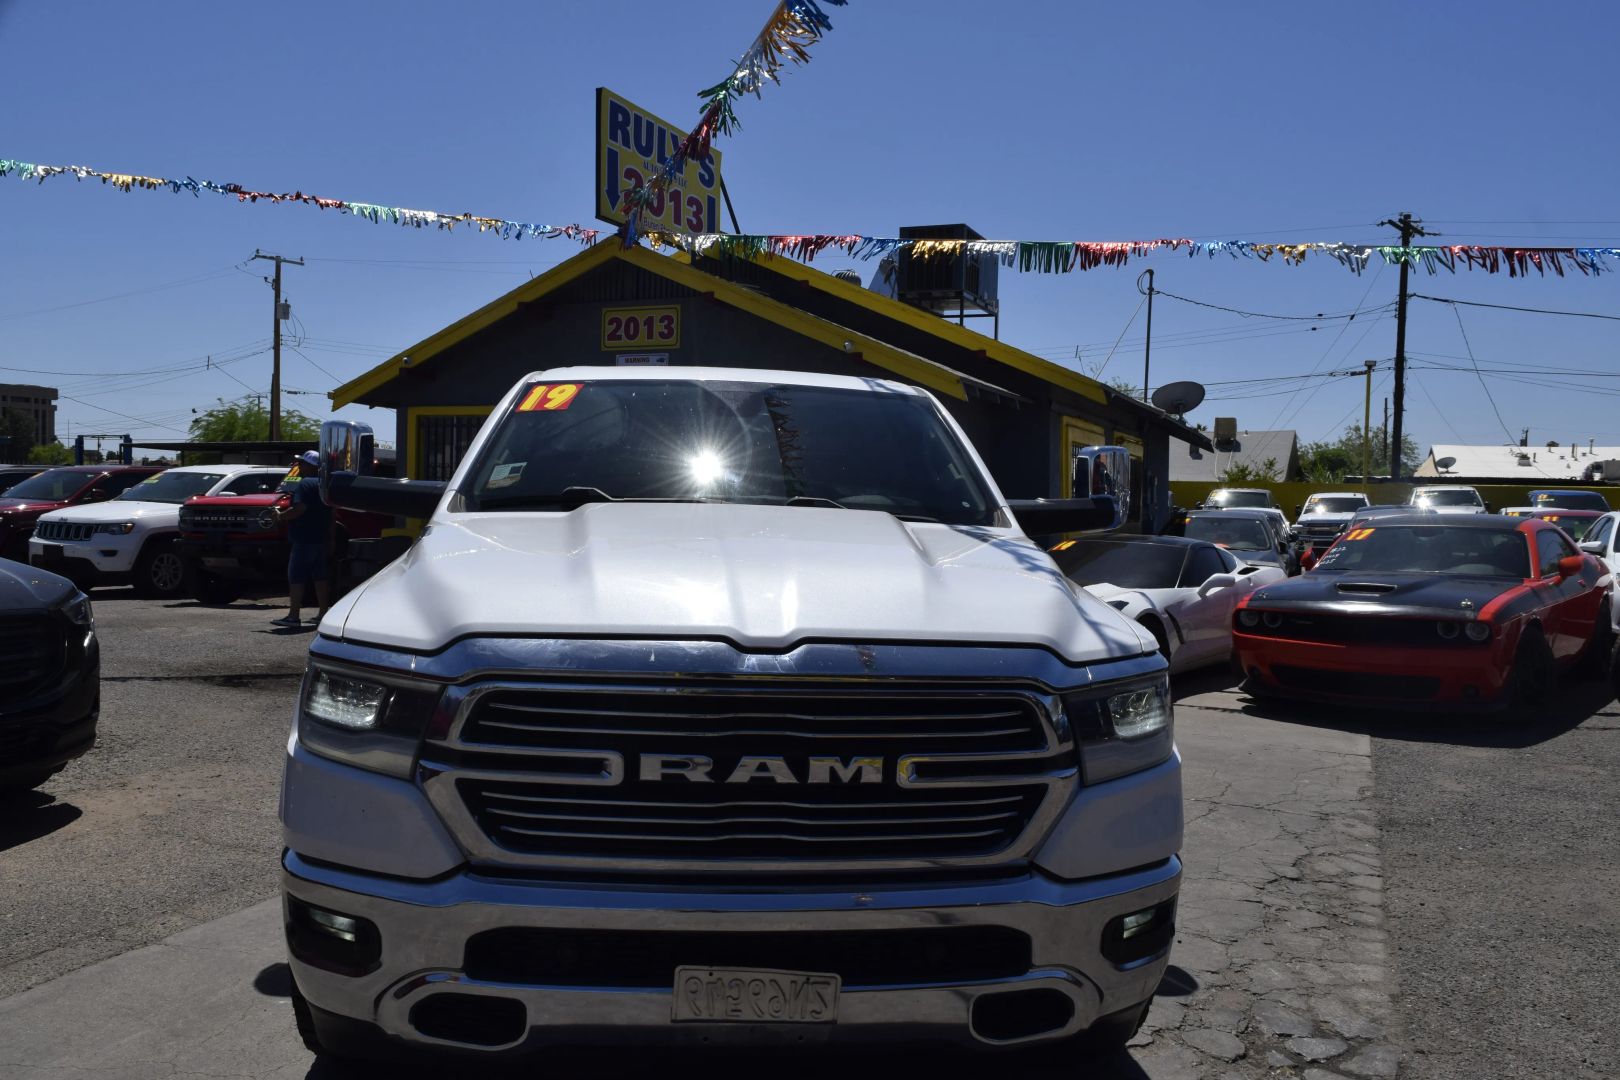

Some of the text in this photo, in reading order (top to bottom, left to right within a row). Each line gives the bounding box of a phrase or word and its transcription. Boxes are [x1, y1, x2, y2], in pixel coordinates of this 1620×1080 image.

[608, 99, 715, 189] RULYS
[607, 314, 675, 342] 2013
[519, 384, 577, 411] 19
[639, 753, 885, 784] RAM
